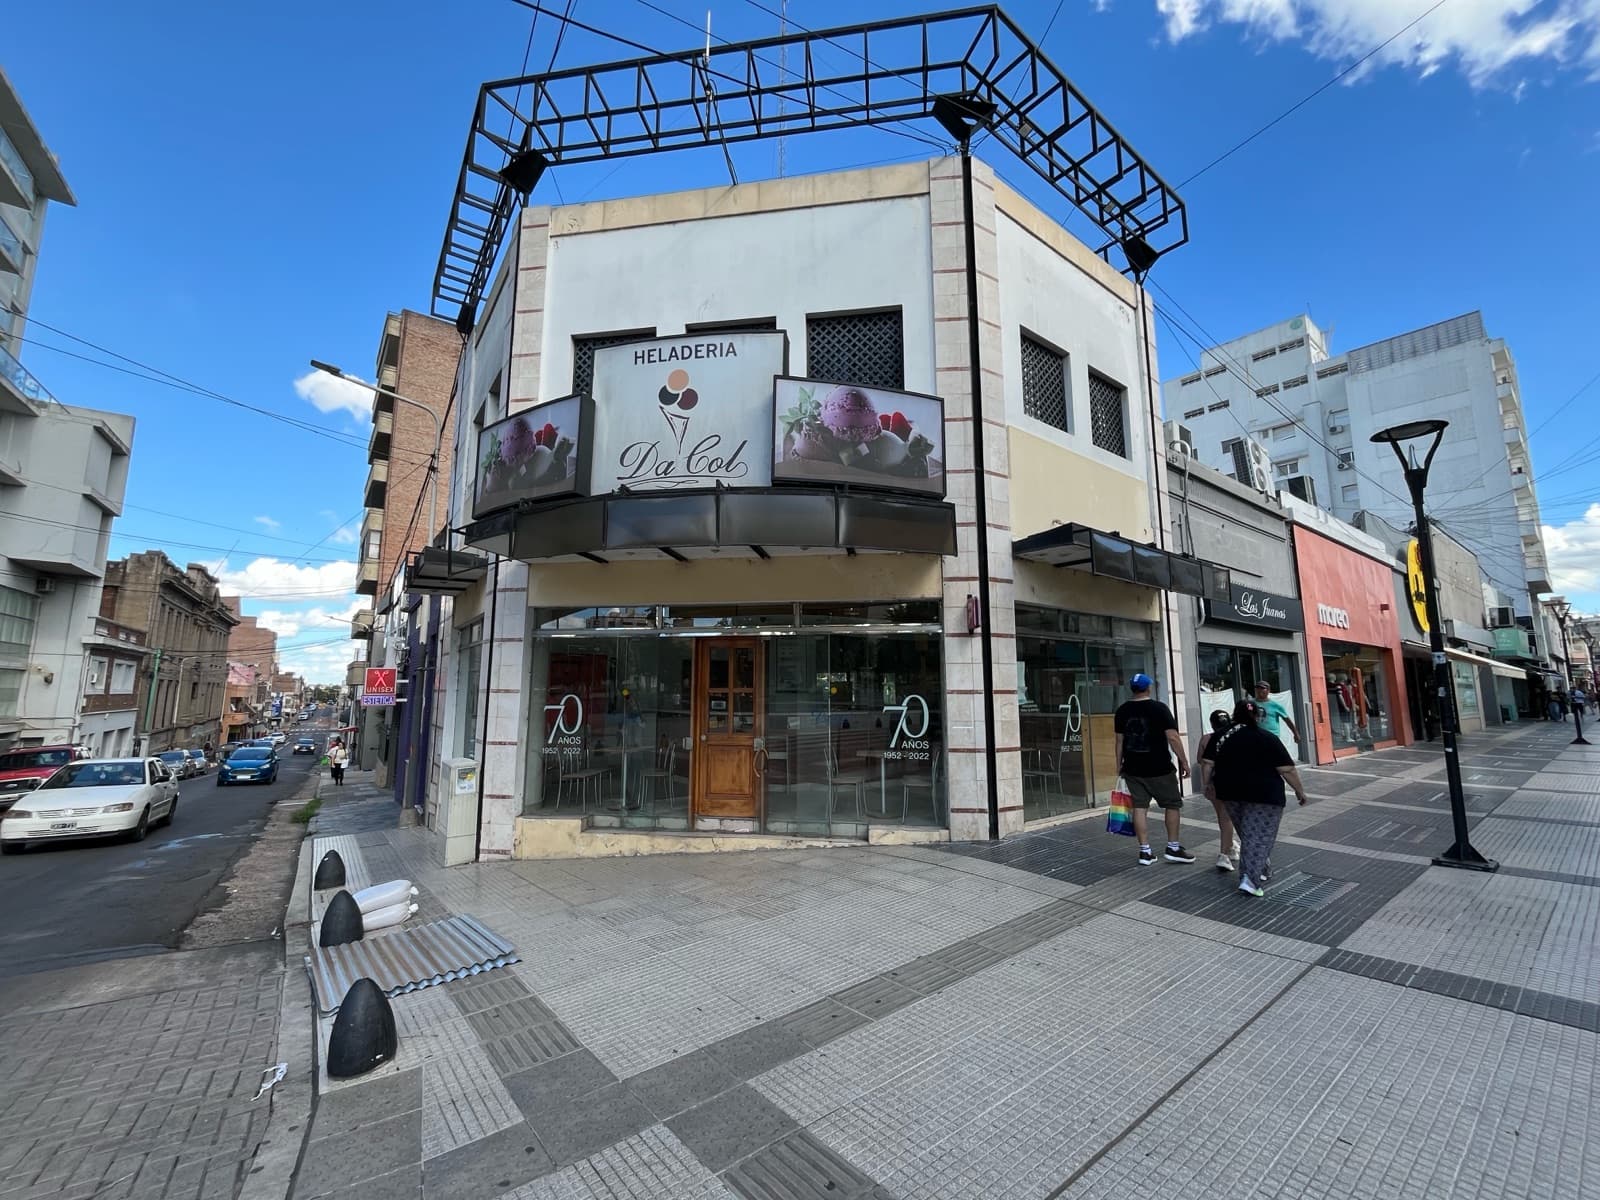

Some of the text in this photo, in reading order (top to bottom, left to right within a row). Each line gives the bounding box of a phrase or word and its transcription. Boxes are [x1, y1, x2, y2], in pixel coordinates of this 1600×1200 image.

[634, 342, 737, 365] HELADERIA
[617, 434, 748, 480] Da Col
[1235, 592, 1287, 620] Las Juanas
[543, 694, 583, 744] 70
[883, 694, 929, 748] 70
[1059, 694, 1081, 742] 70
[558, 735, 581, 745] AÑOS
[901, 739, 930, 749] AÑOS
[908, 752, 929, 760] 2022
